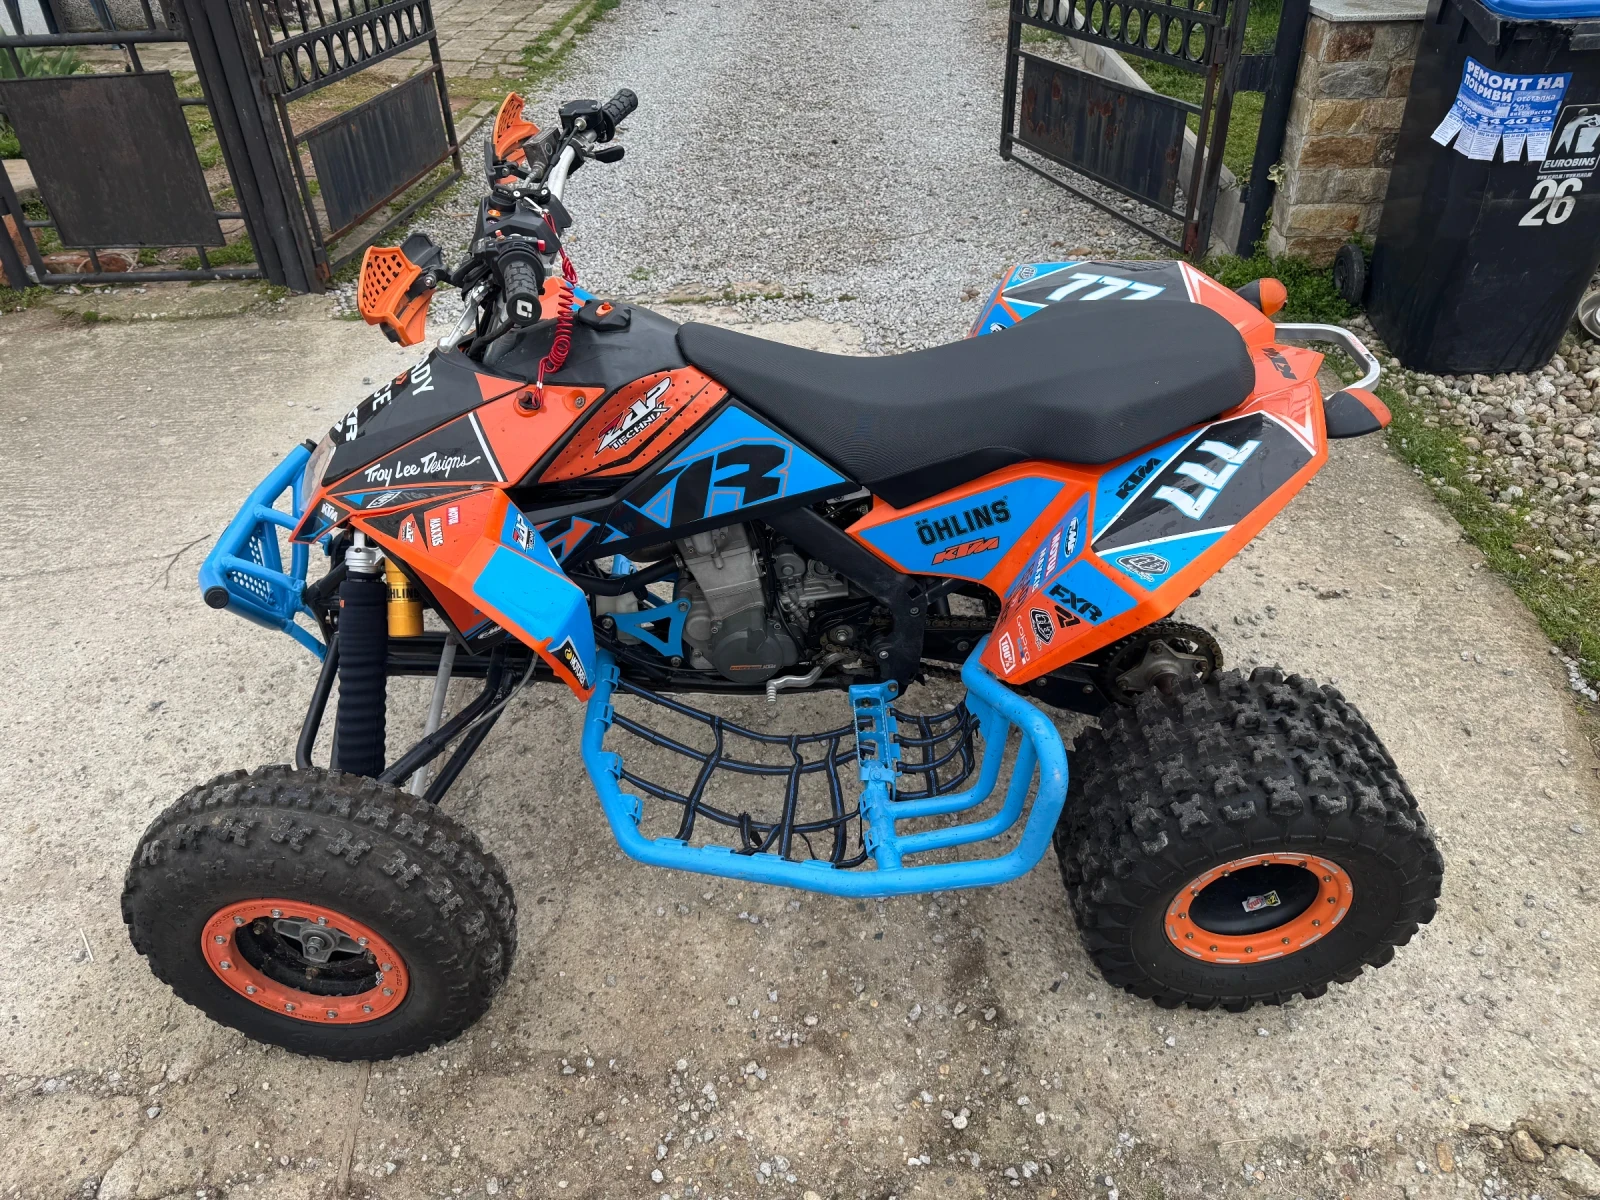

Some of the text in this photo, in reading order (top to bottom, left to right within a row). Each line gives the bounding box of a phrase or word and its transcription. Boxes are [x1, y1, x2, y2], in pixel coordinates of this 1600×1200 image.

[1464, 73, 1513, 103] ПОКРИВИ
[1467, 60, 1565, 91] РЕМОНТ НА
[1456, 100, 1478, 120] 0892
[1480, 115, 1501, 126] 34
[1503, 117, 1528, 126] 40
[1531, 116, 1552, 124] 59
[1543, 157, 1596, 168] EUROBINS
[1518, 178, 1583, 227] 26
[1045, 272, 1166, 301] 777
[410, 354, 435, 396] ADY
[608, 400, 672, 451] TECHNIX
[364, 451, 481, 487] Troy Lee Designs
[1115, 457, 1162, 500] KTM
[1151, 439, 1263, 521] 777
[321, 502, 339, 523] KTM
[915, 500, 1011, 546] ÖHLINS
[429, 517, 444, 547] MAXXIS
[931, 535, 1000, 566] KTM
[1049, 581, 1103, 622] FXR
[1001, 639, 1013, 668] 100%
